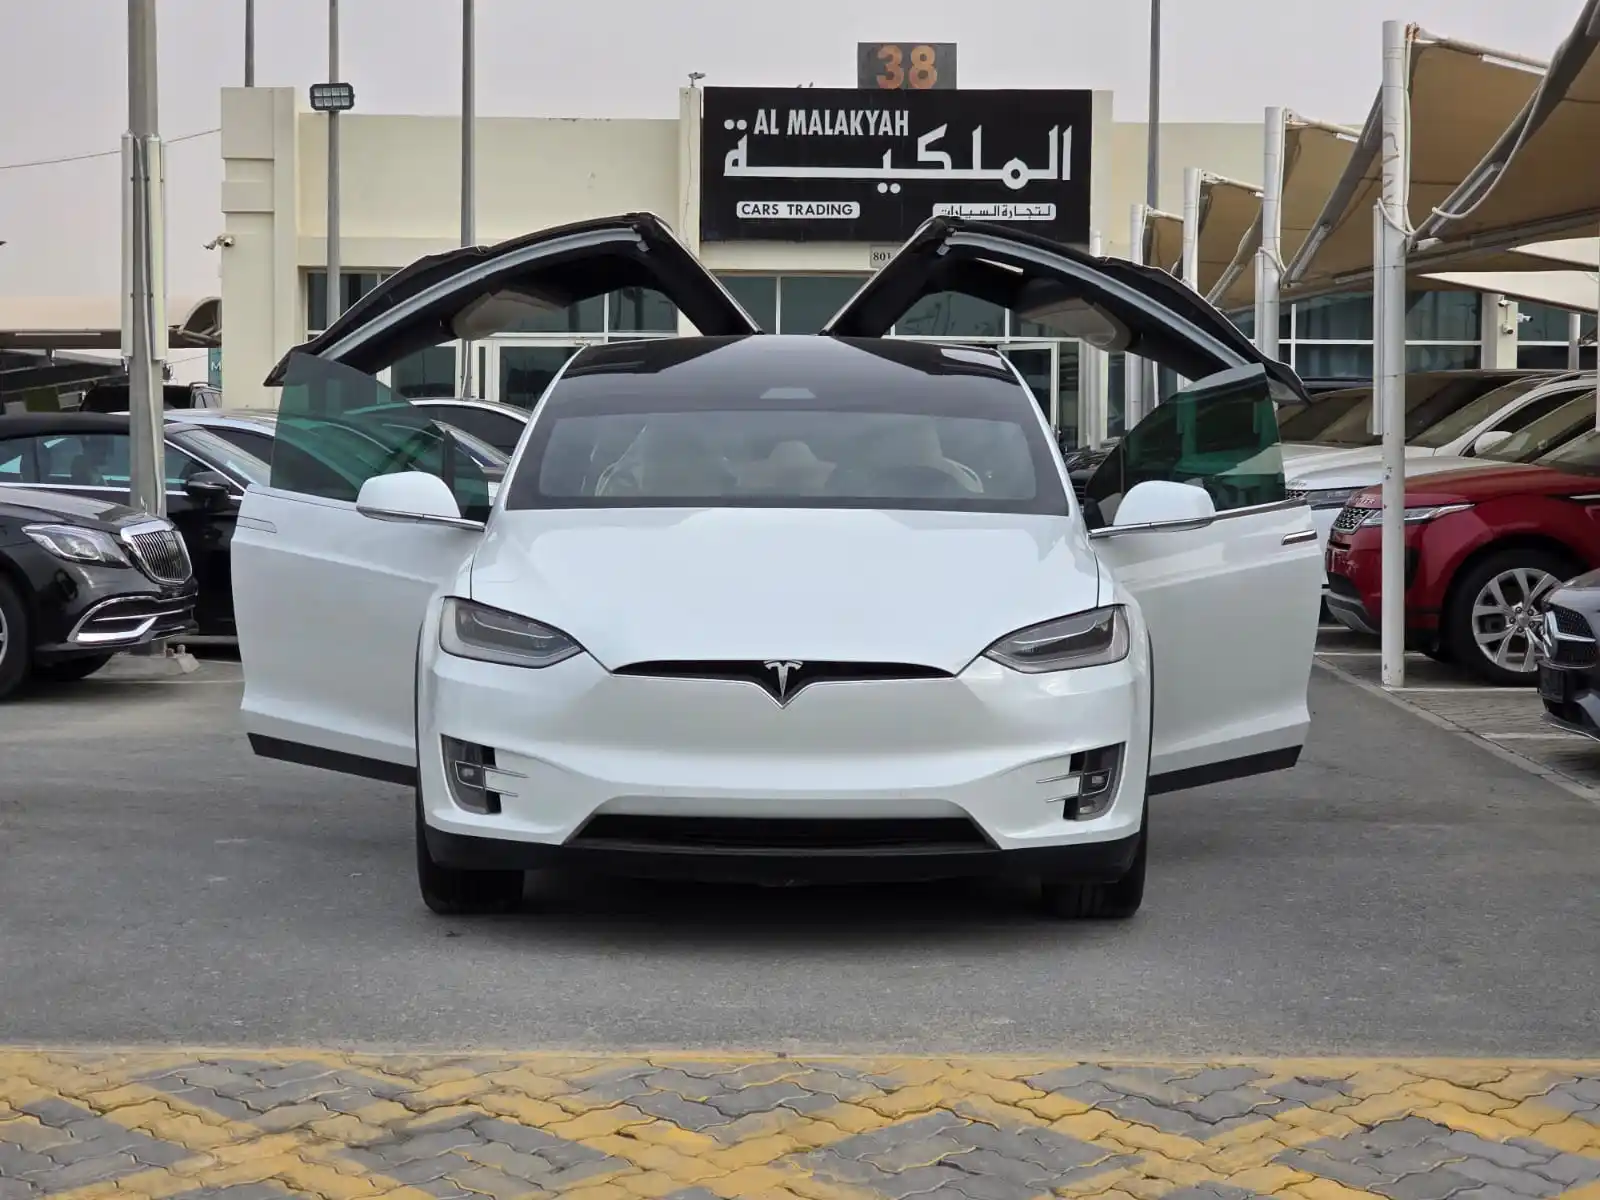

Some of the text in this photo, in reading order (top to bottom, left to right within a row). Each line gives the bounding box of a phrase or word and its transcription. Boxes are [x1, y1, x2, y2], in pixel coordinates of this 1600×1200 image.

[876, 44, 937, 90] 38
[753, 109, 909, 136] AL MALAKYAH
[723, 118, 1072, 193] الملكية
[741, 204, 854, 215] CARS TRADING
